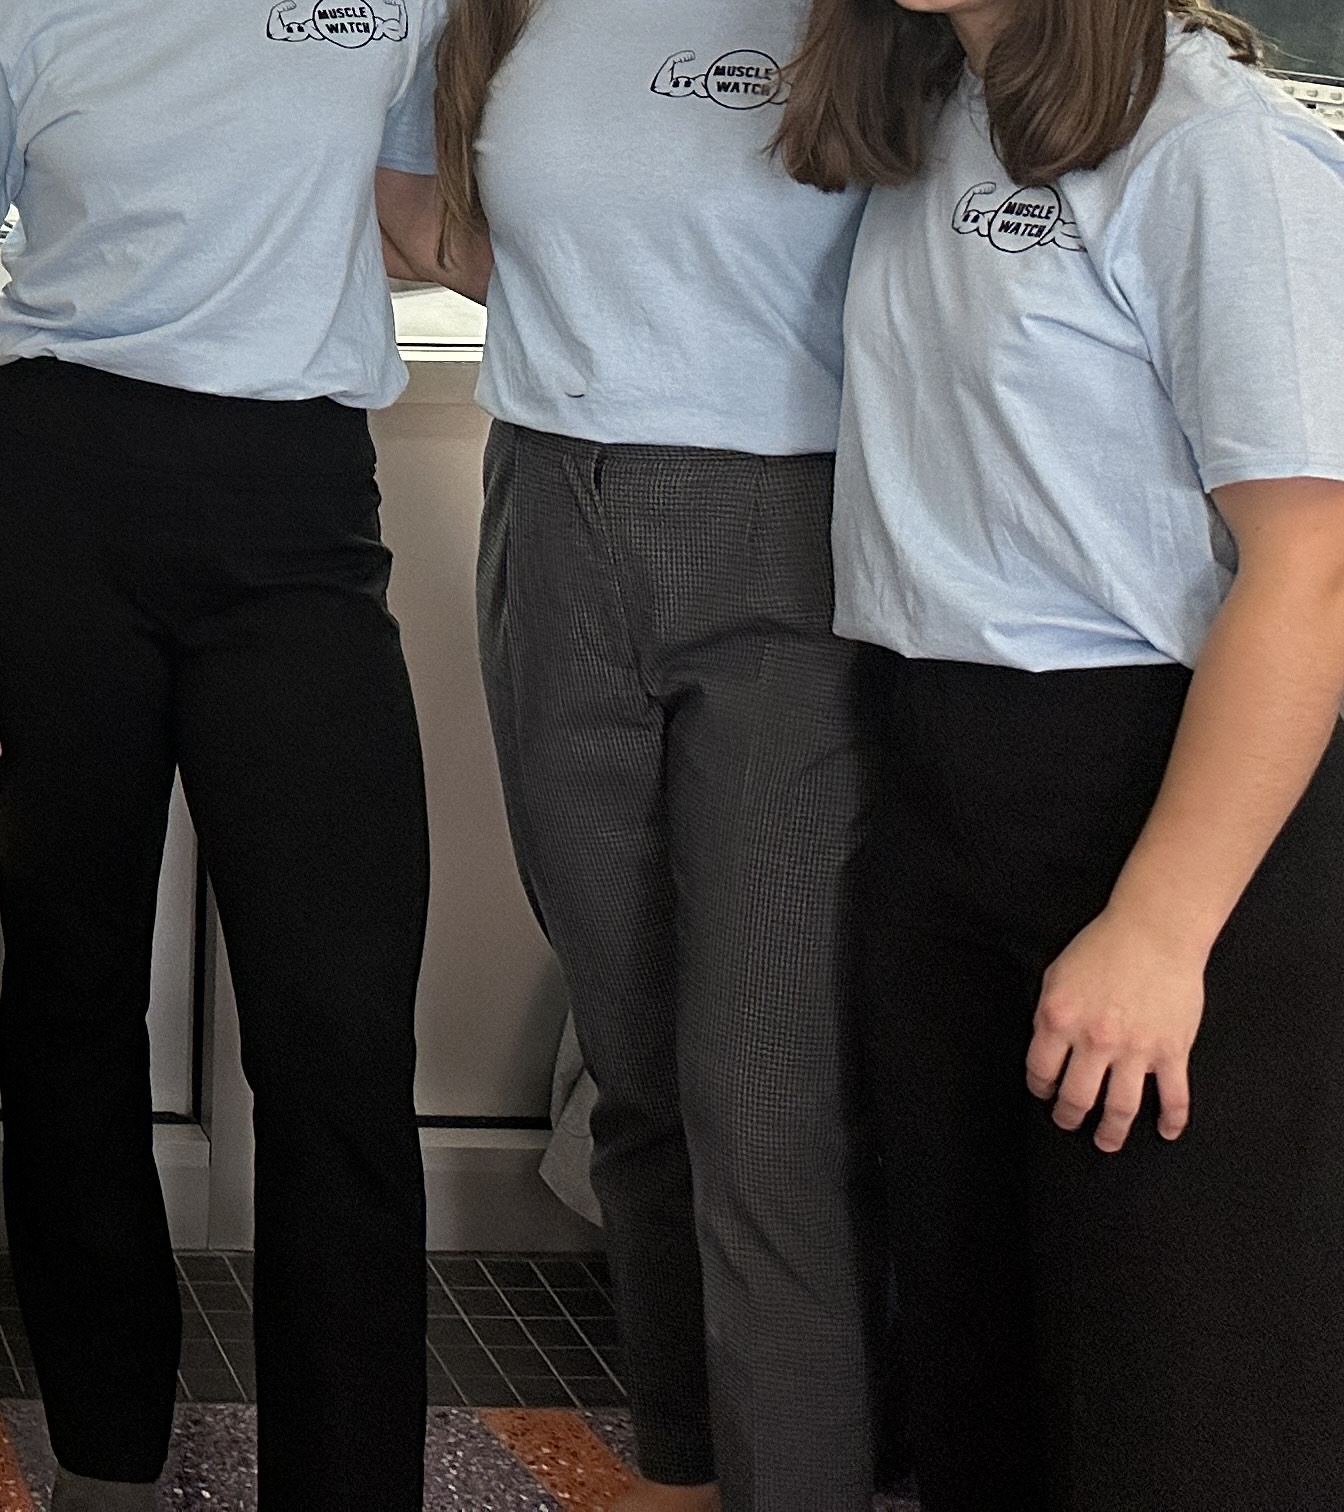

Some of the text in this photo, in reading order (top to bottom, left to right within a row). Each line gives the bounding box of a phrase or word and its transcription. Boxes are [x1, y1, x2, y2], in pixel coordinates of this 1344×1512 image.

[317, 6, 369, 20] MUSCLE
[325, 21, 371, 34] WATCH
[713, 64, 774, 80] MUSCLE
[716, 81, 772, 97] WATCH
[1002, 201, 1055, 220] MUSCLE
[998, 219, 1047, 238] WATCH
